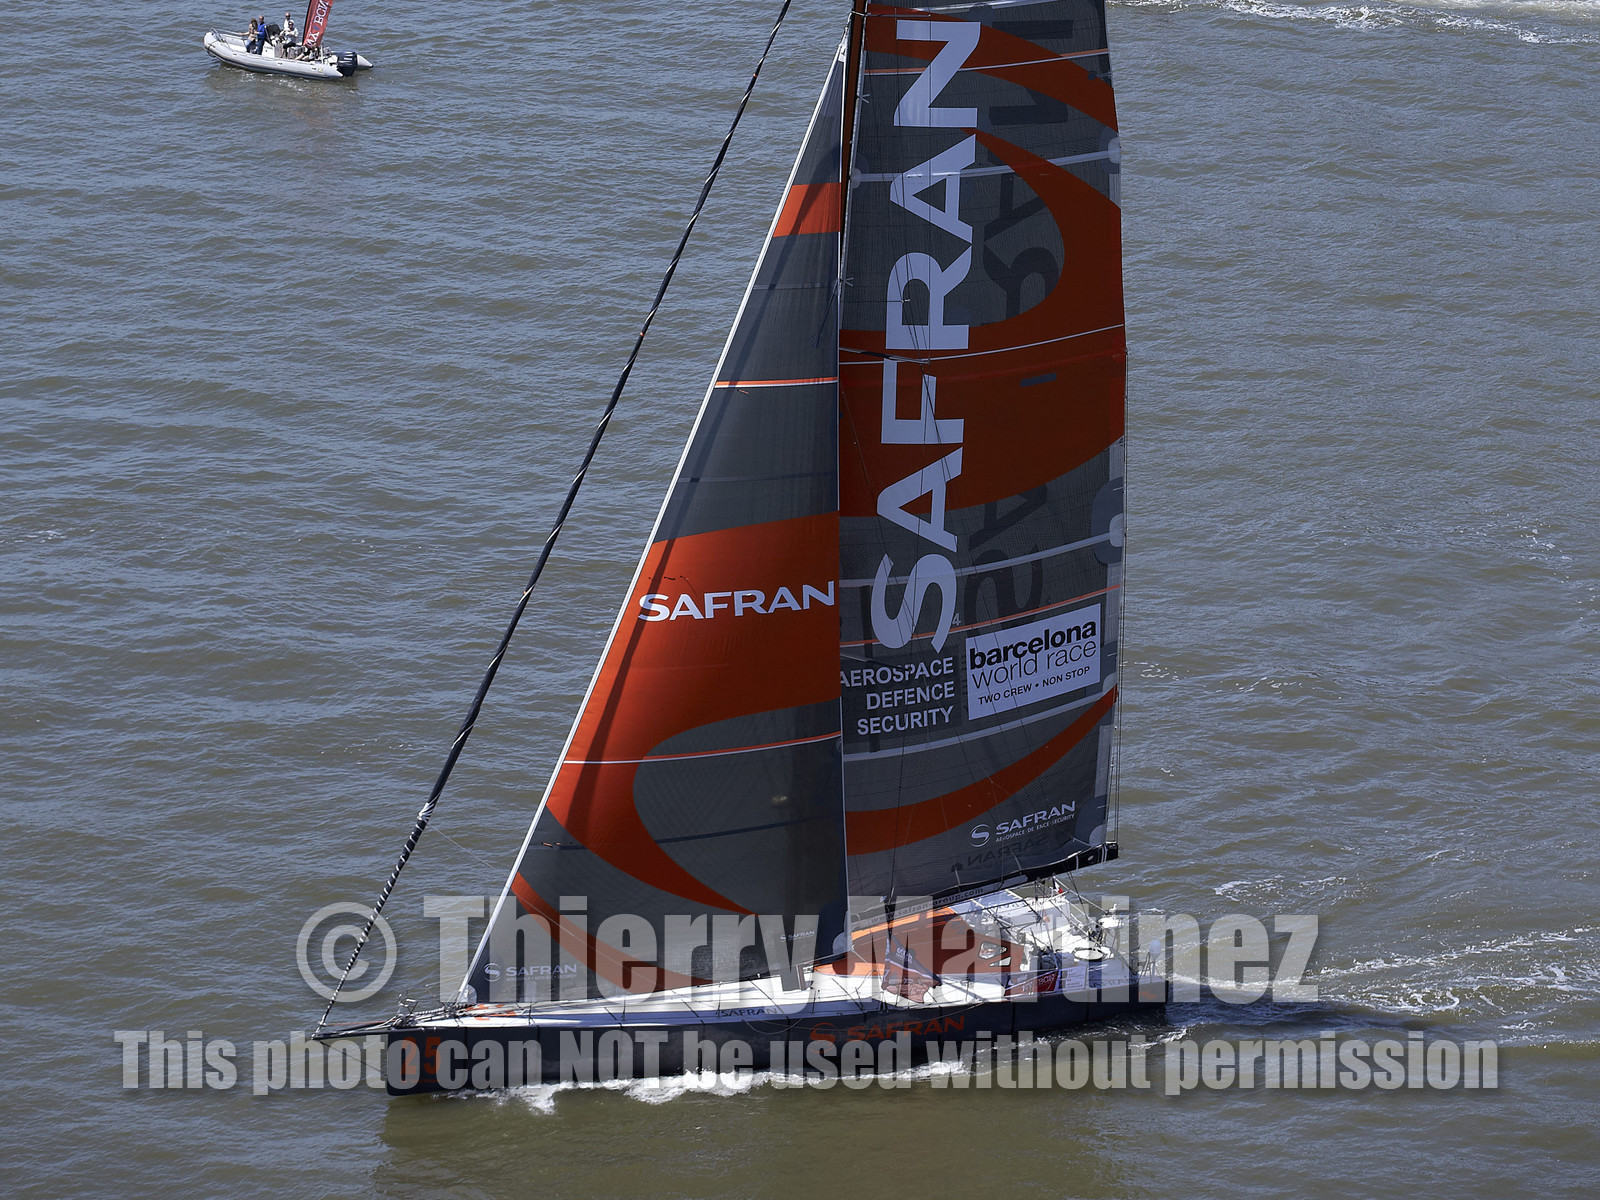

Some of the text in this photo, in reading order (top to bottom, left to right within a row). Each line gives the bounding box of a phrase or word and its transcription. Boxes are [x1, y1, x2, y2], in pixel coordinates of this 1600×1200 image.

[870, 19, 981, 653] SAFRAN
[638, 580, 835, 622] SAFRAN
[969, 621, 1097, 670] barcelona
[840, 657, 954, 688] AEROSPACE
[972, 640, 1097, 689] world race
[866, 681, 955, 710] DEFENCE
[978, 666, 1091, 705] TWO CREW NON STOP
[857, 706, 954, 736] SECURITY
[995, 801, 1076, 835] SAFRAN
[506, 963, 577, 977] SAFRAN
[848, 1015, 965, 1042] SAFRAN
[401, 1036, 442, 1075] 25
